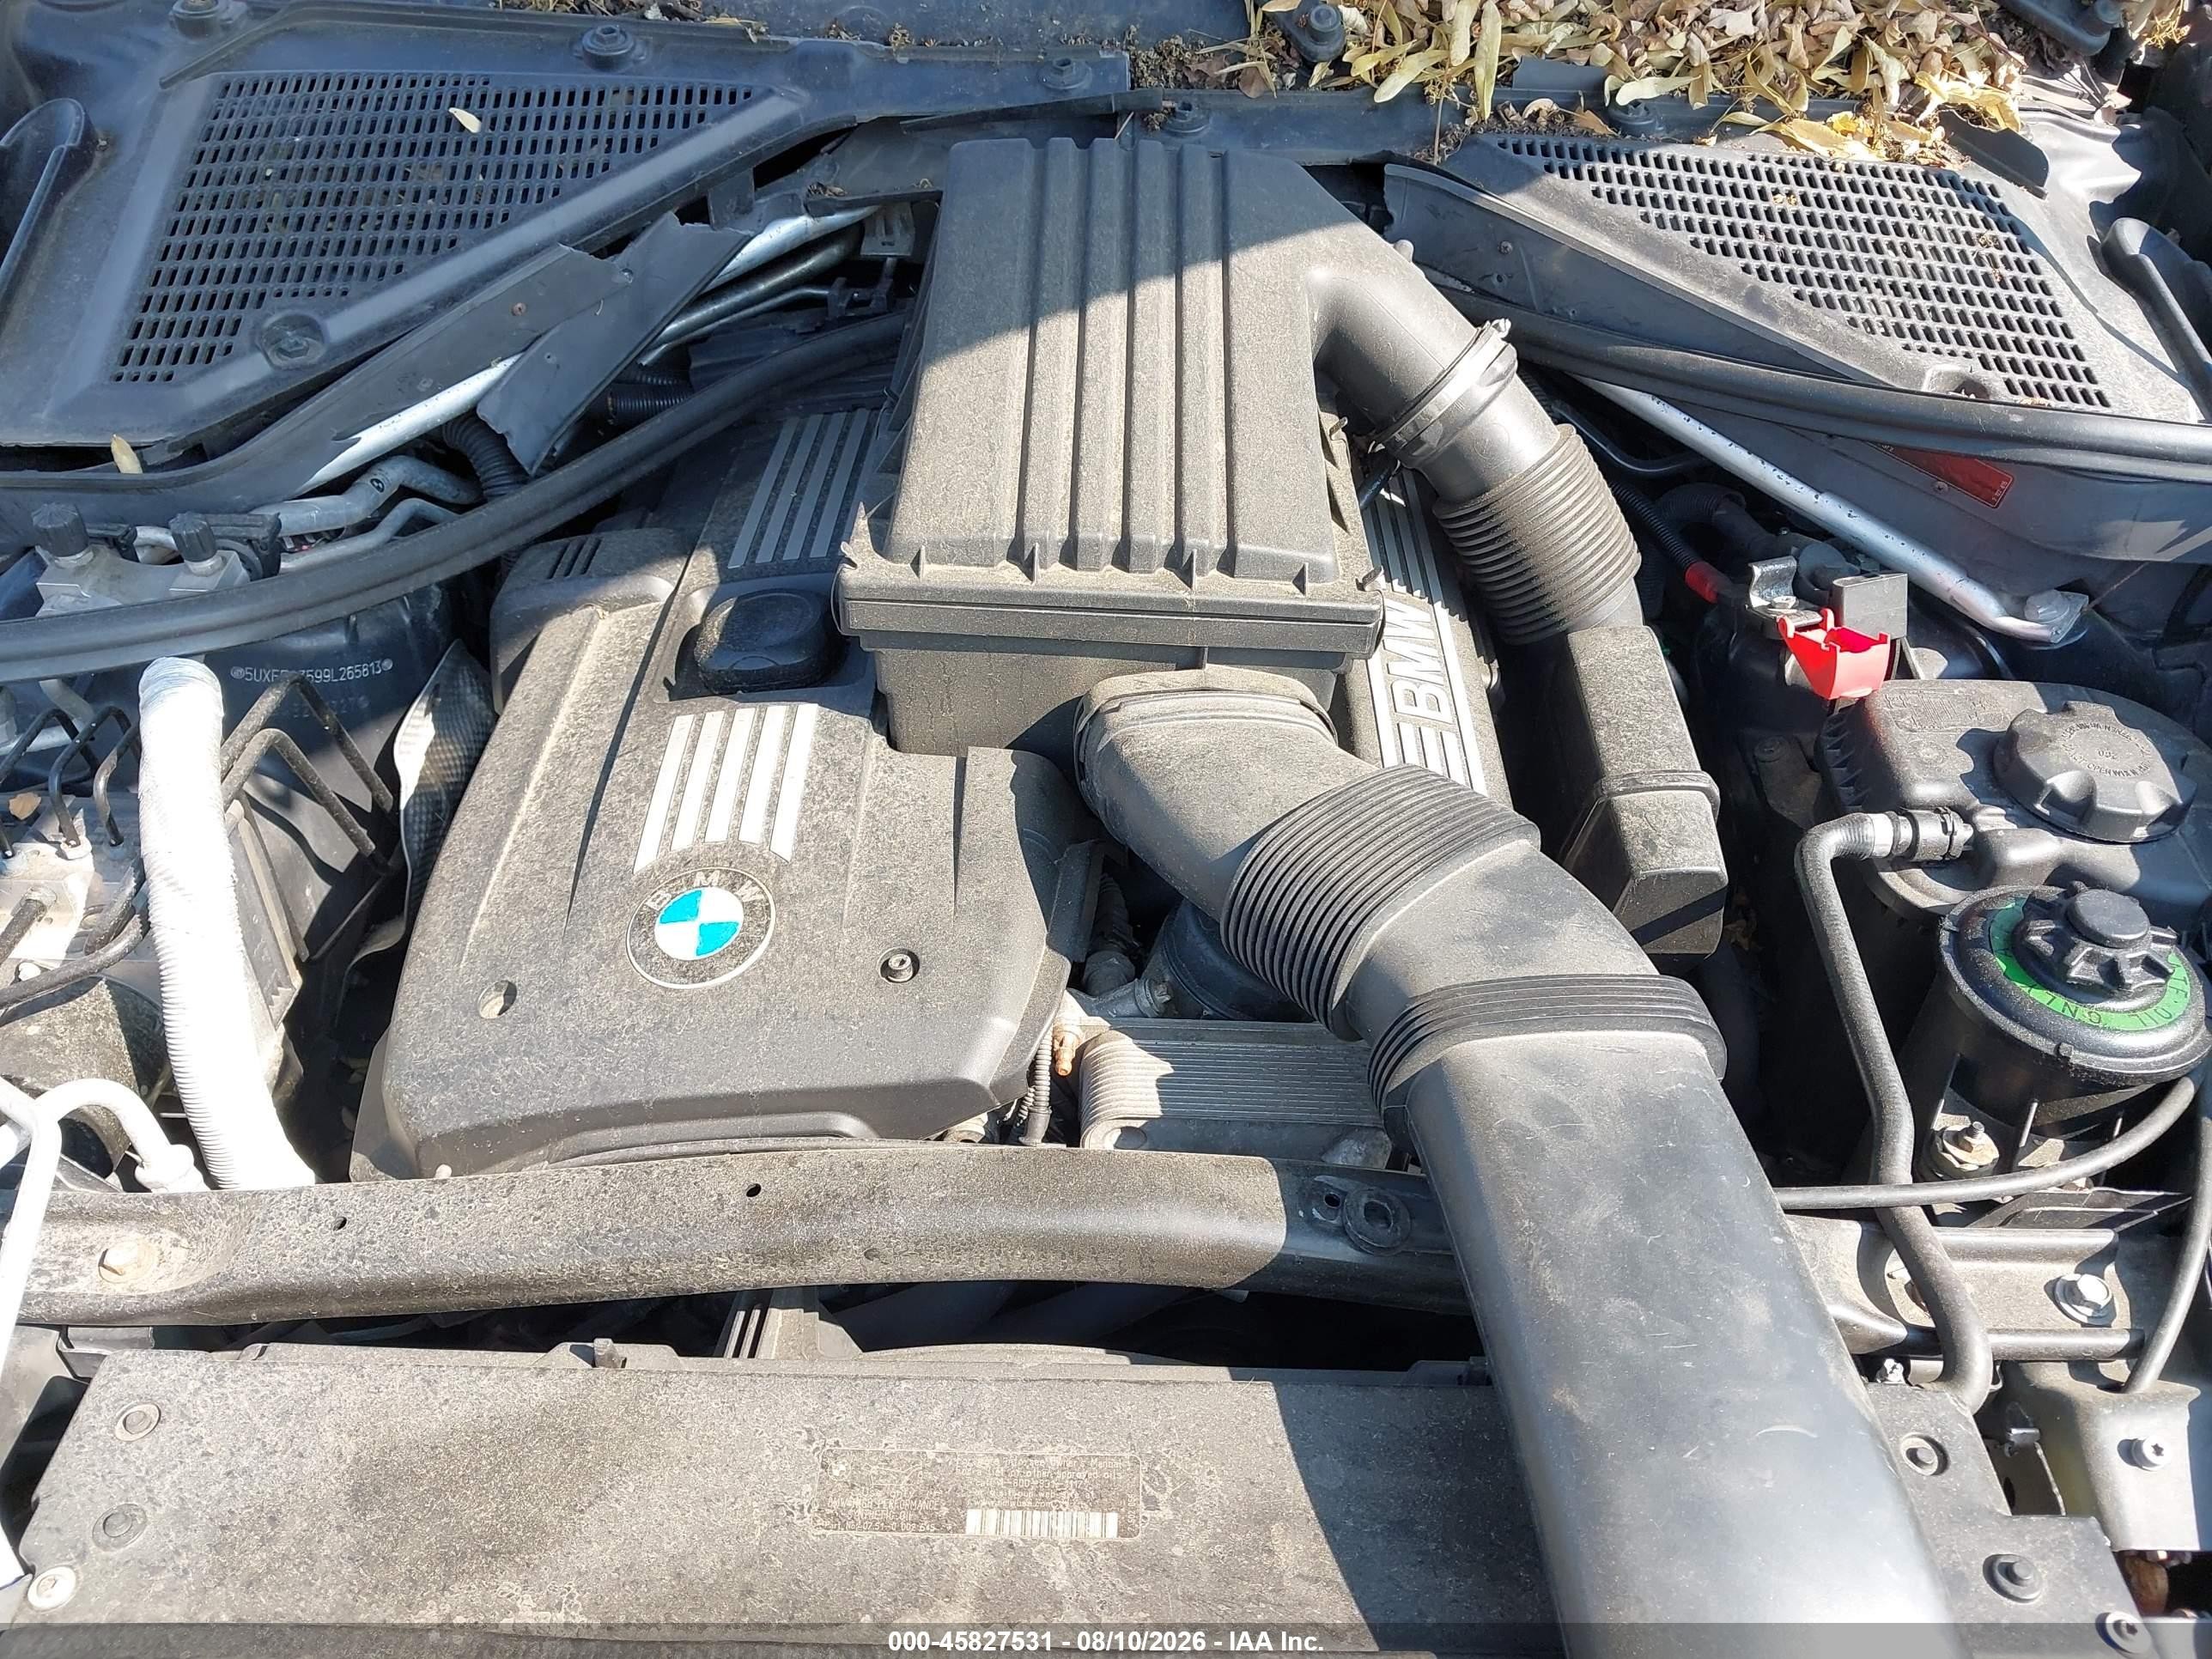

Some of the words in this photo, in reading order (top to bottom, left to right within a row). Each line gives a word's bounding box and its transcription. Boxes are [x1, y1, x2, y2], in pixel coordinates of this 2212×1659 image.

[245, 660, 382, 684] 5UXF599L265813
[1382, 599, 1454, 726] BMW
[645, 869, 767, 911] BMW
